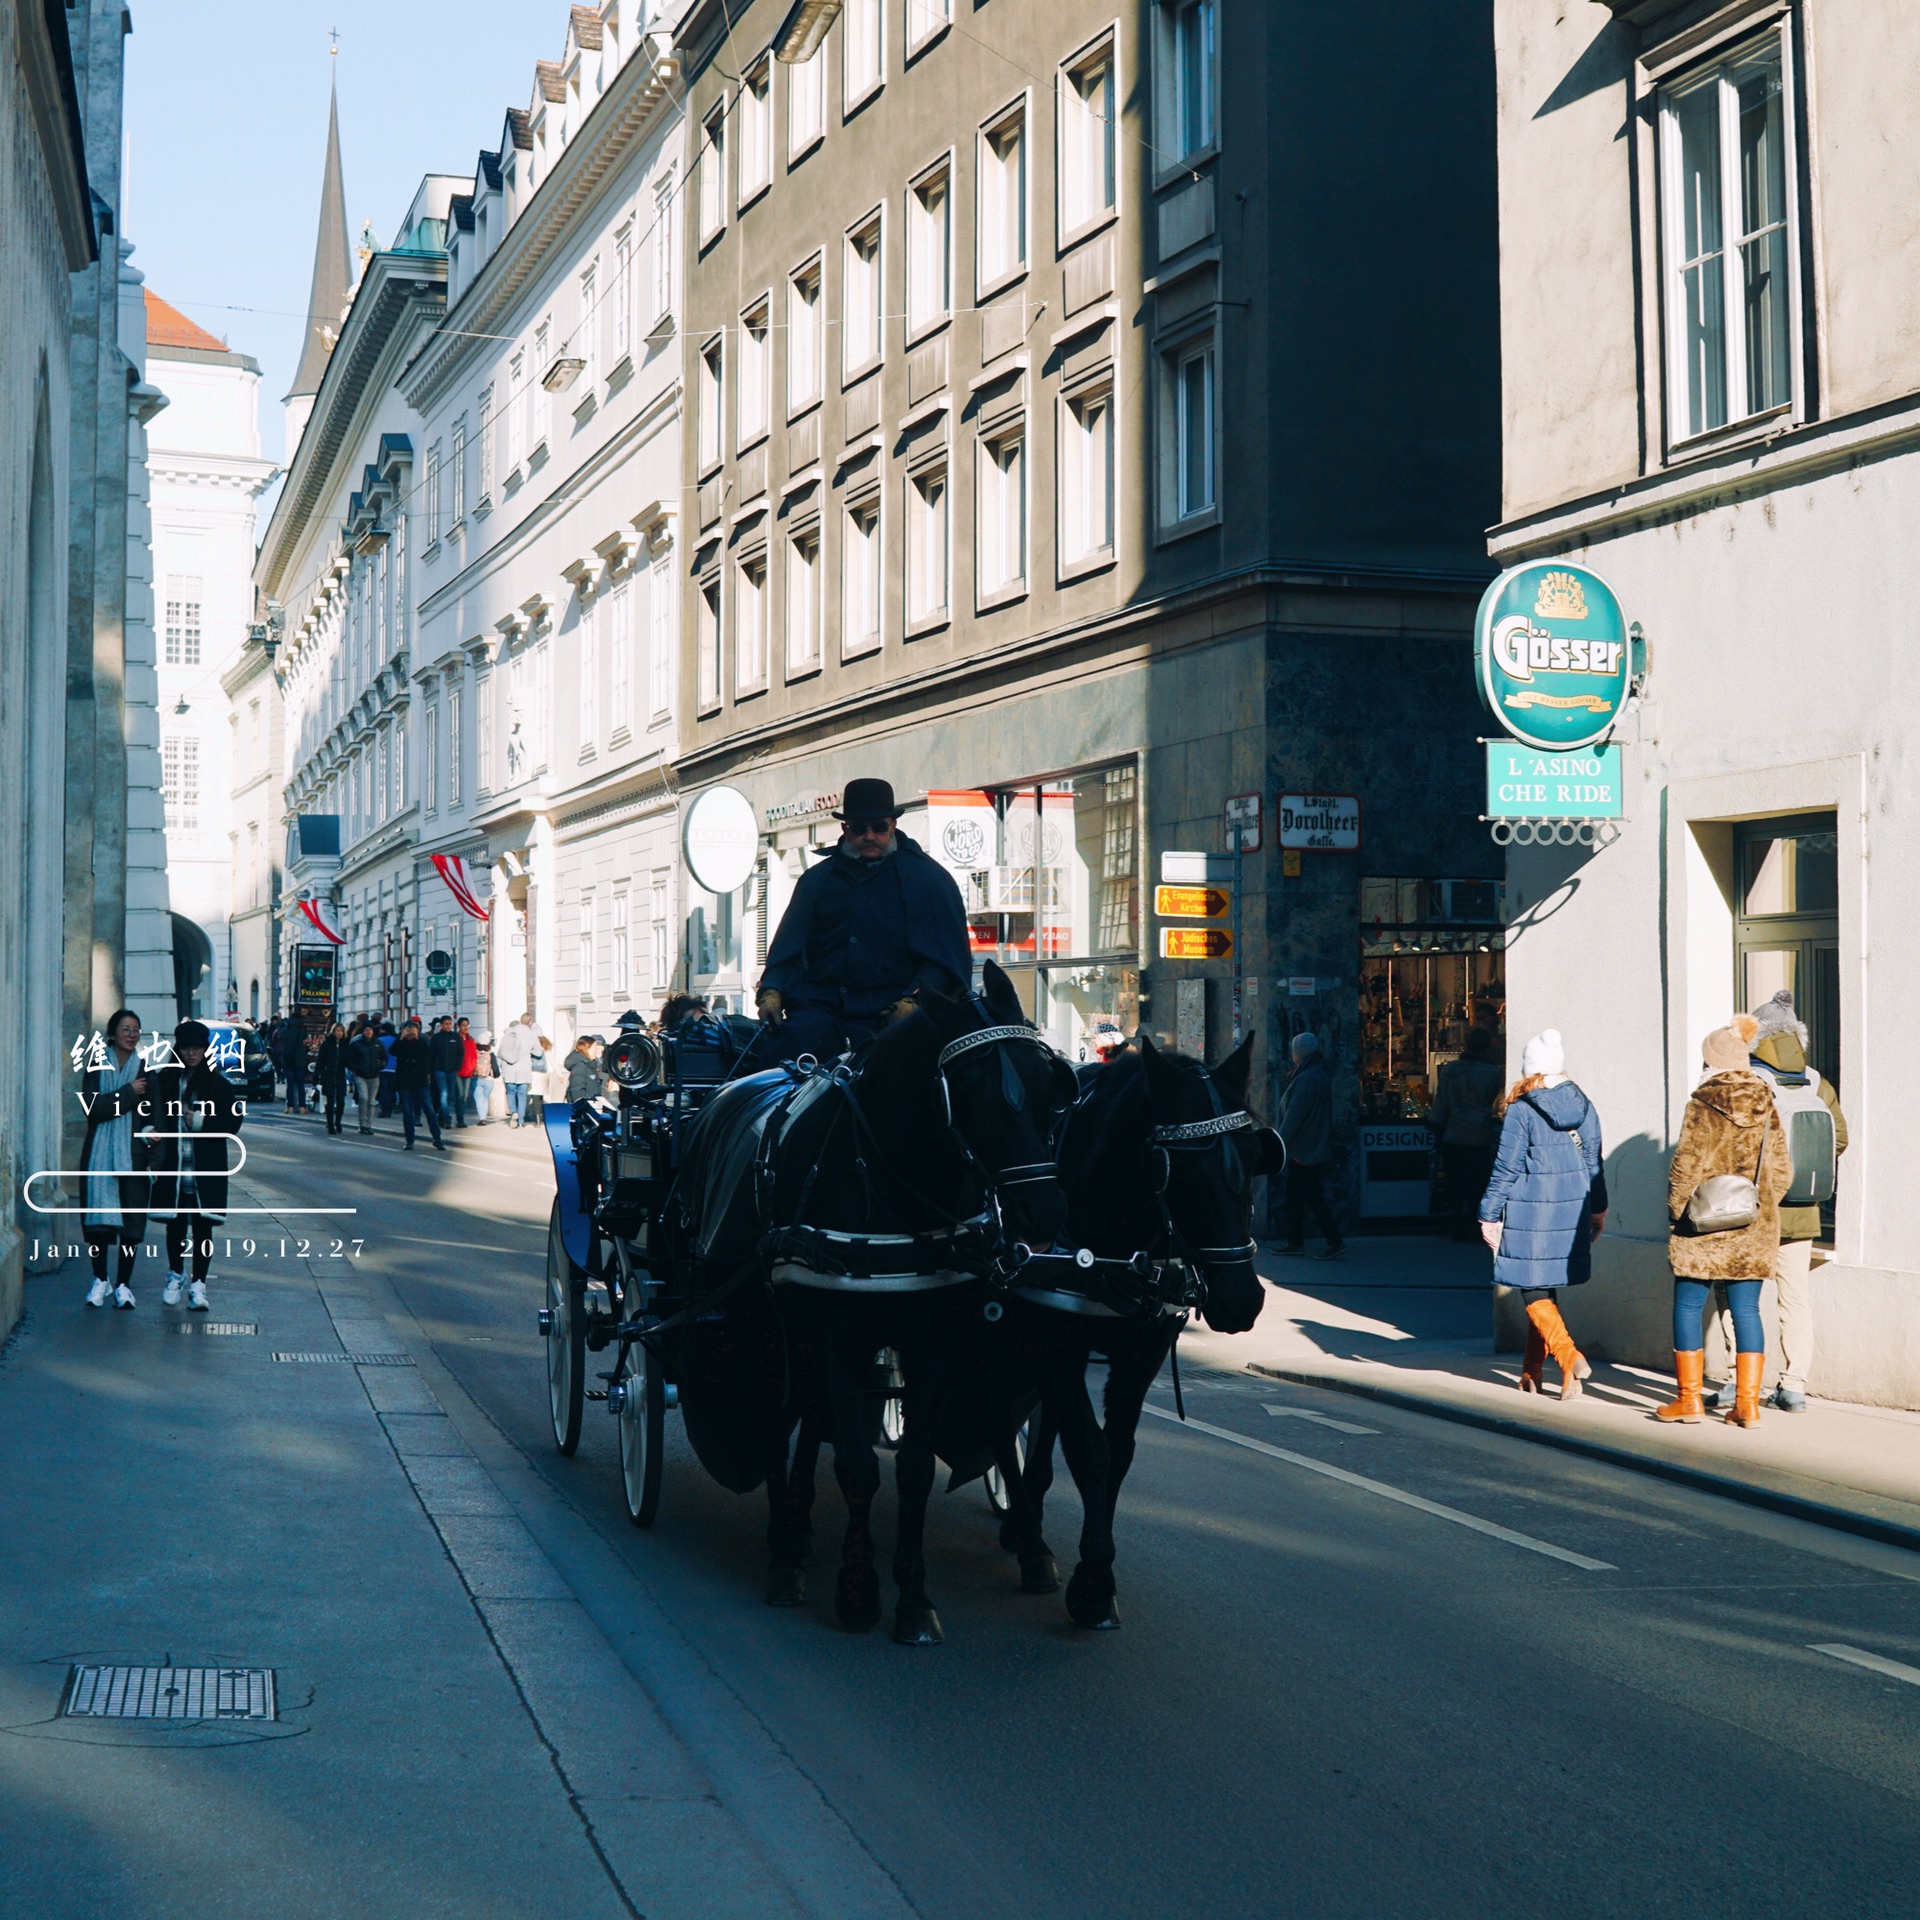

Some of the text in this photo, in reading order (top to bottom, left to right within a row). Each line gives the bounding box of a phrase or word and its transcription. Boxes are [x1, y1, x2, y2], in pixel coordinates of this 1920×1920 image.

[1493, 614, 1622, 681] Gösser
[1499, 784, 1611, 803] CHE RIDE
[951, 820, 974, 834] THE
[947, 825, 981, 850] WORLD
[1172, 890, 1216, 902] Evangelische
[1180, 902, 1207, 913] Kirchen
[1183, 944, 1214, 954] Museum
[1364, 1132, 1436, 1146] DESIGNE
